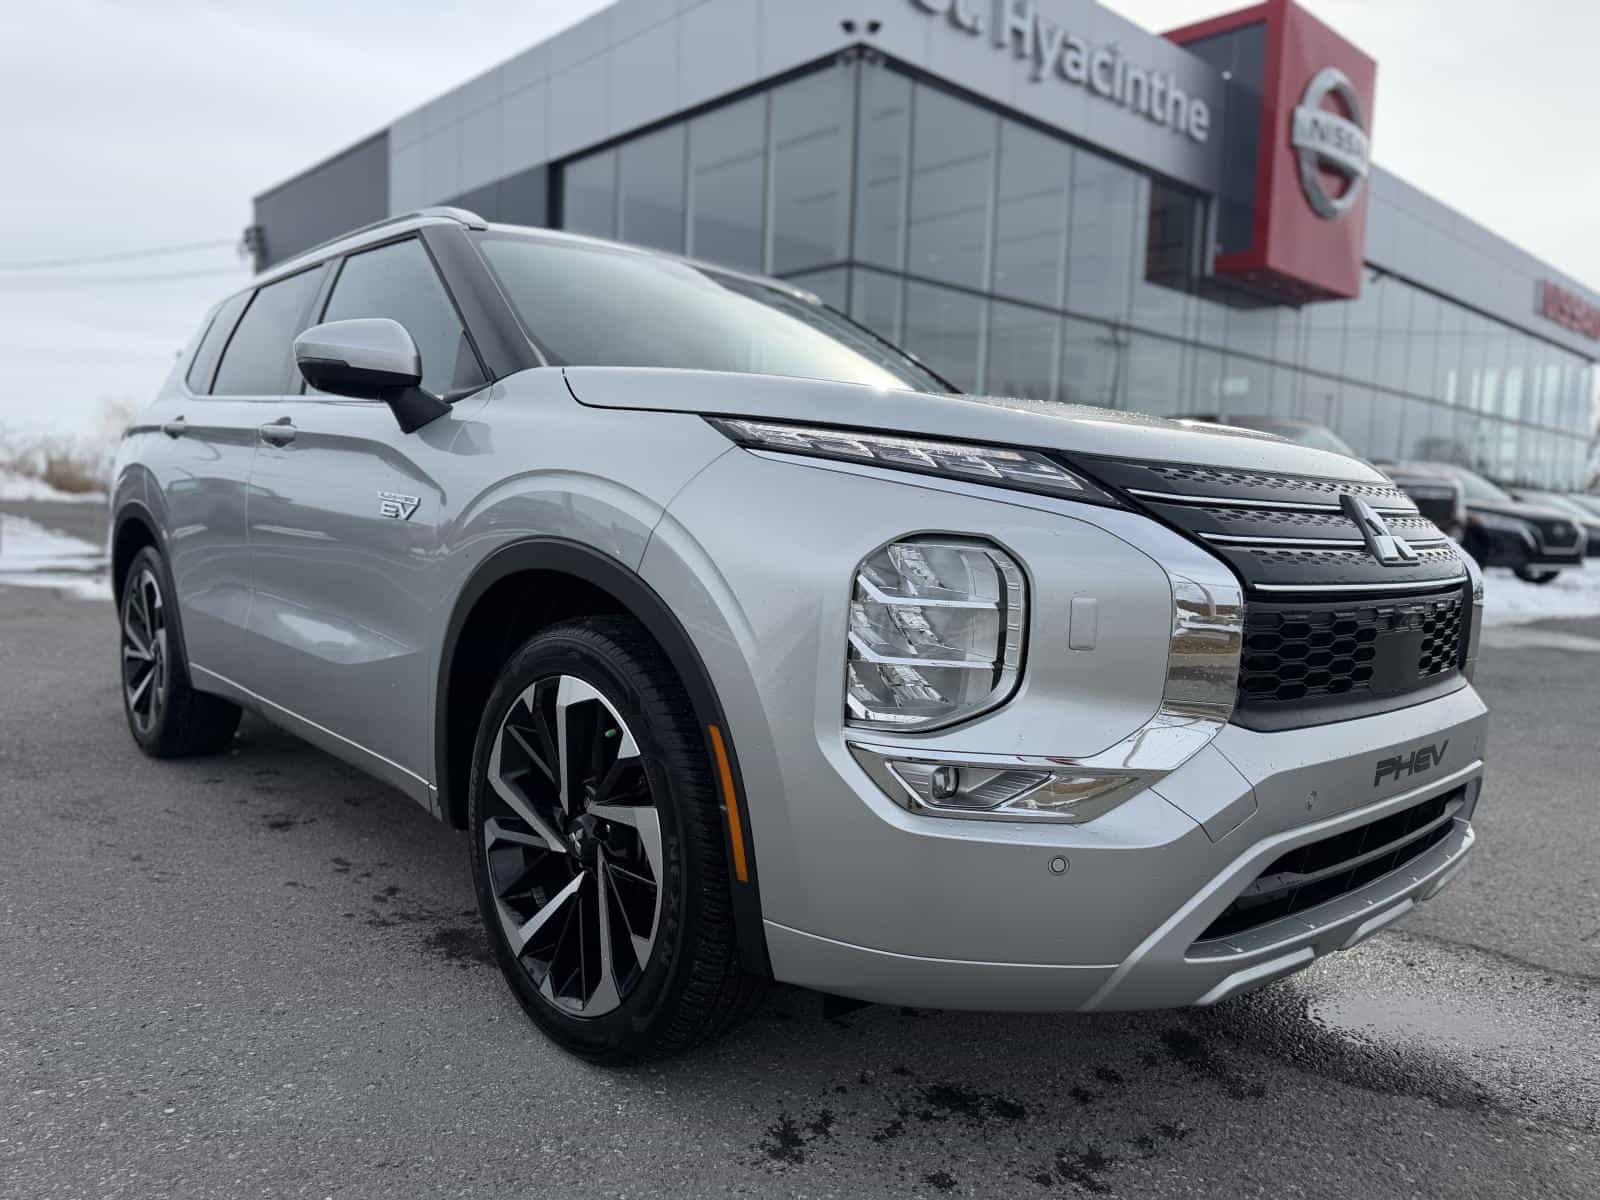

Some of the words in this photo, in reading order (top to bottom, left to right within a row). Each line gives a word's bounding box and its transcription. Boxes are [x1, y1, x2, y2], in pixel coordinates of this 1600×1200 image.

[991, 0, 1210, 142] Hyacinthe
[380, 500, 420, 520] EV
[1374, 739, 1449, 787] PHEV
